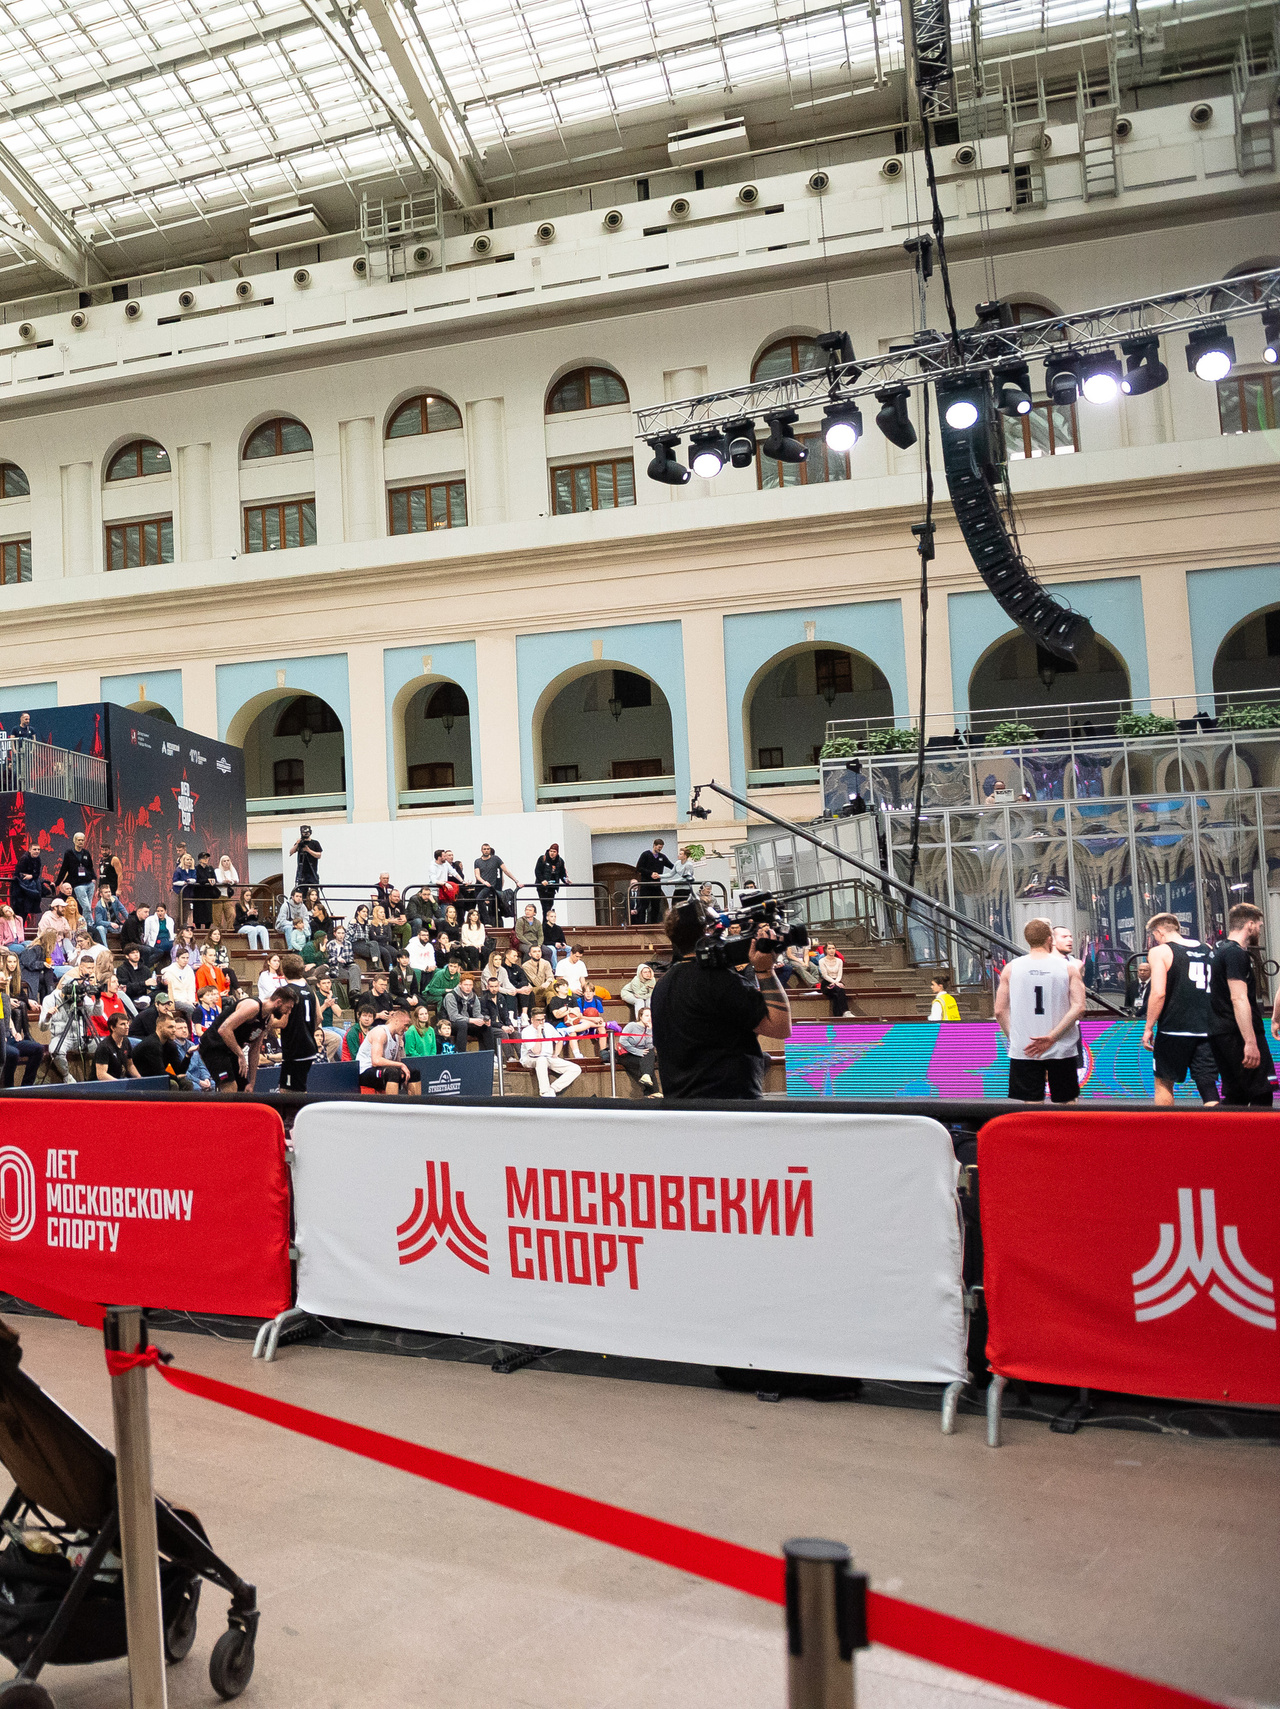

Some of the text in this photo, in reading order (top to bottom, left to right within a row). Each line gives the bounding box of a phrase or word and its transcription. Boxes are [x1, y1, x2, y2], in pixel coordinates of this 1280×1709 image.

[1033, 985, 1045, 1015] 1
[45, 1148, 79, 1180] ЛЕТ
[46, 1182, 194, 1221] МОСКОВСКОМУ
[505, 1166, 814, 1237] МОСКОВСКИЙ
[47, 1216, 120, 1252] СПОРТУ
[508, 1225, 644, 1290] СПОРТ
